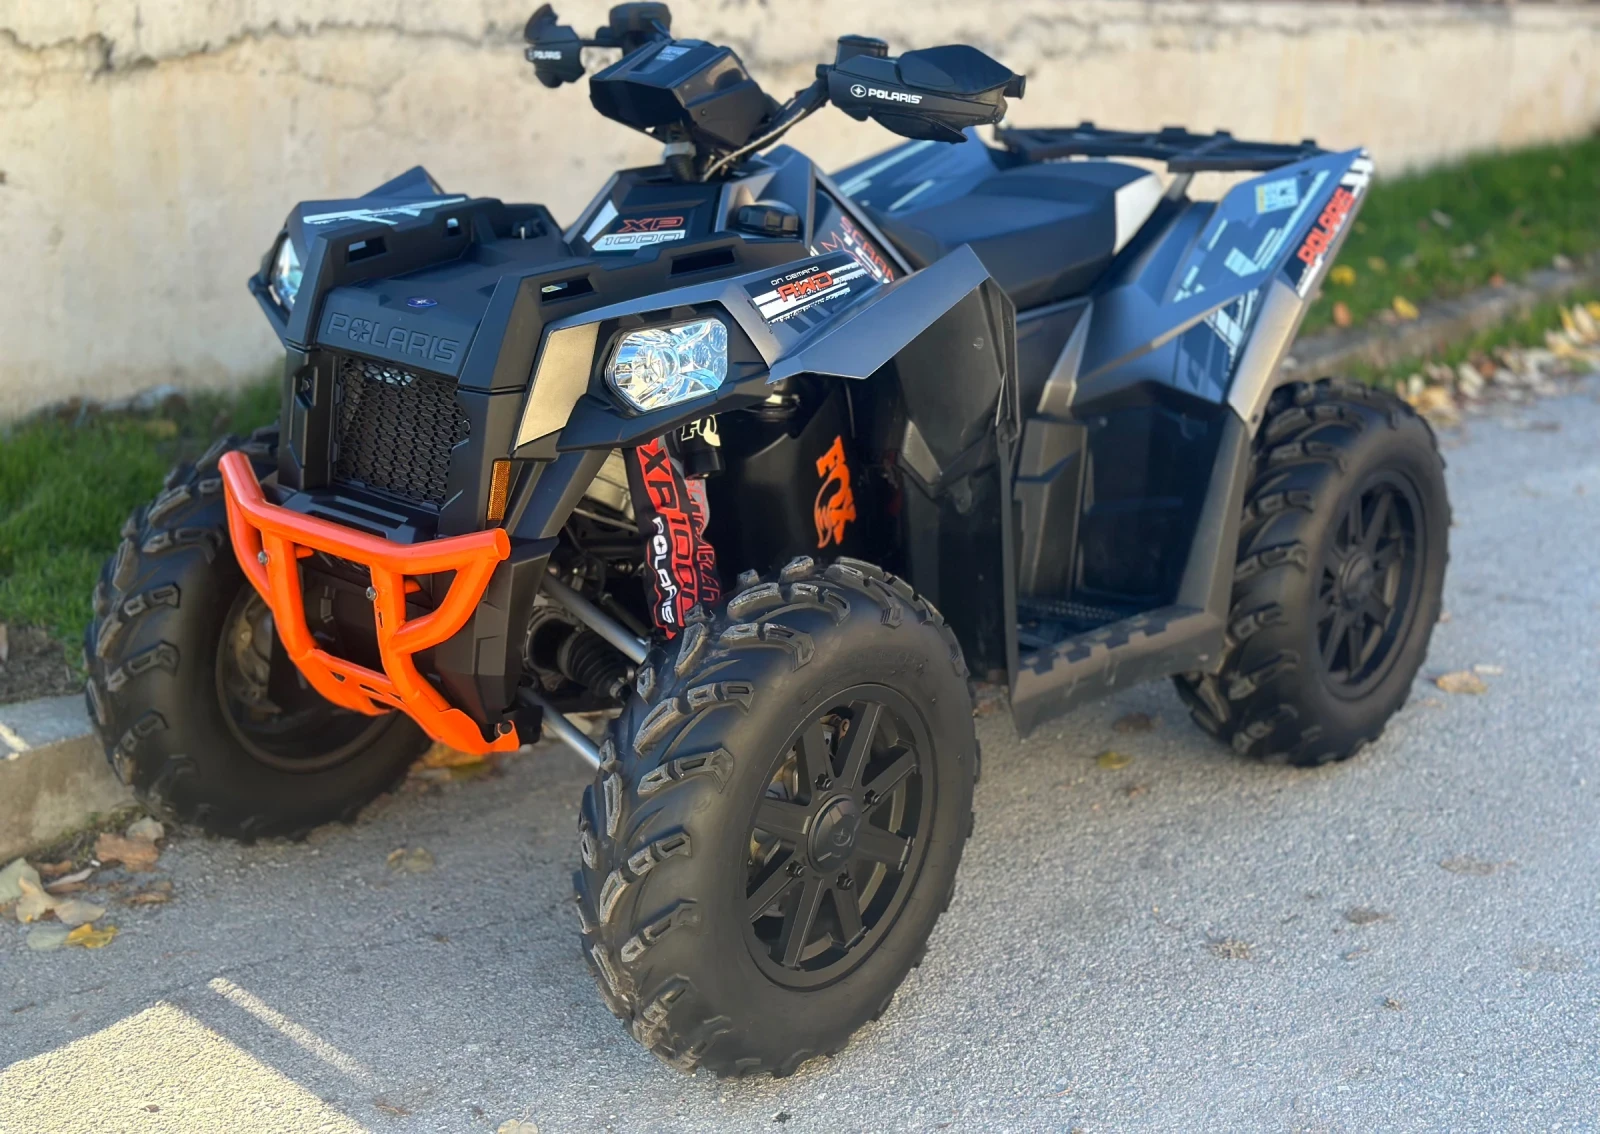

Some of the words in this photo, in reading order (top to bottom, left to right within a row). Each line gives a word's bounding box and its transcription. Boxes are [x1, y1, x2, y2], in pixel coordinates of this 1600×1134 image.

[868, 88, 923, 105] POLARIS
[605, 232, 682, 246] 1000
[617, 216, 684, 233] XP
[1297, 187, 1355, 267] POLARIS
[776, 271, 834, 302] AWD
[785, 266, 819, 281] DEMAND
[326, 312, 460, 364] POLARIS
[814, 435, 857, 549] FOX
[652, 516, 678, 625] POLARIS
